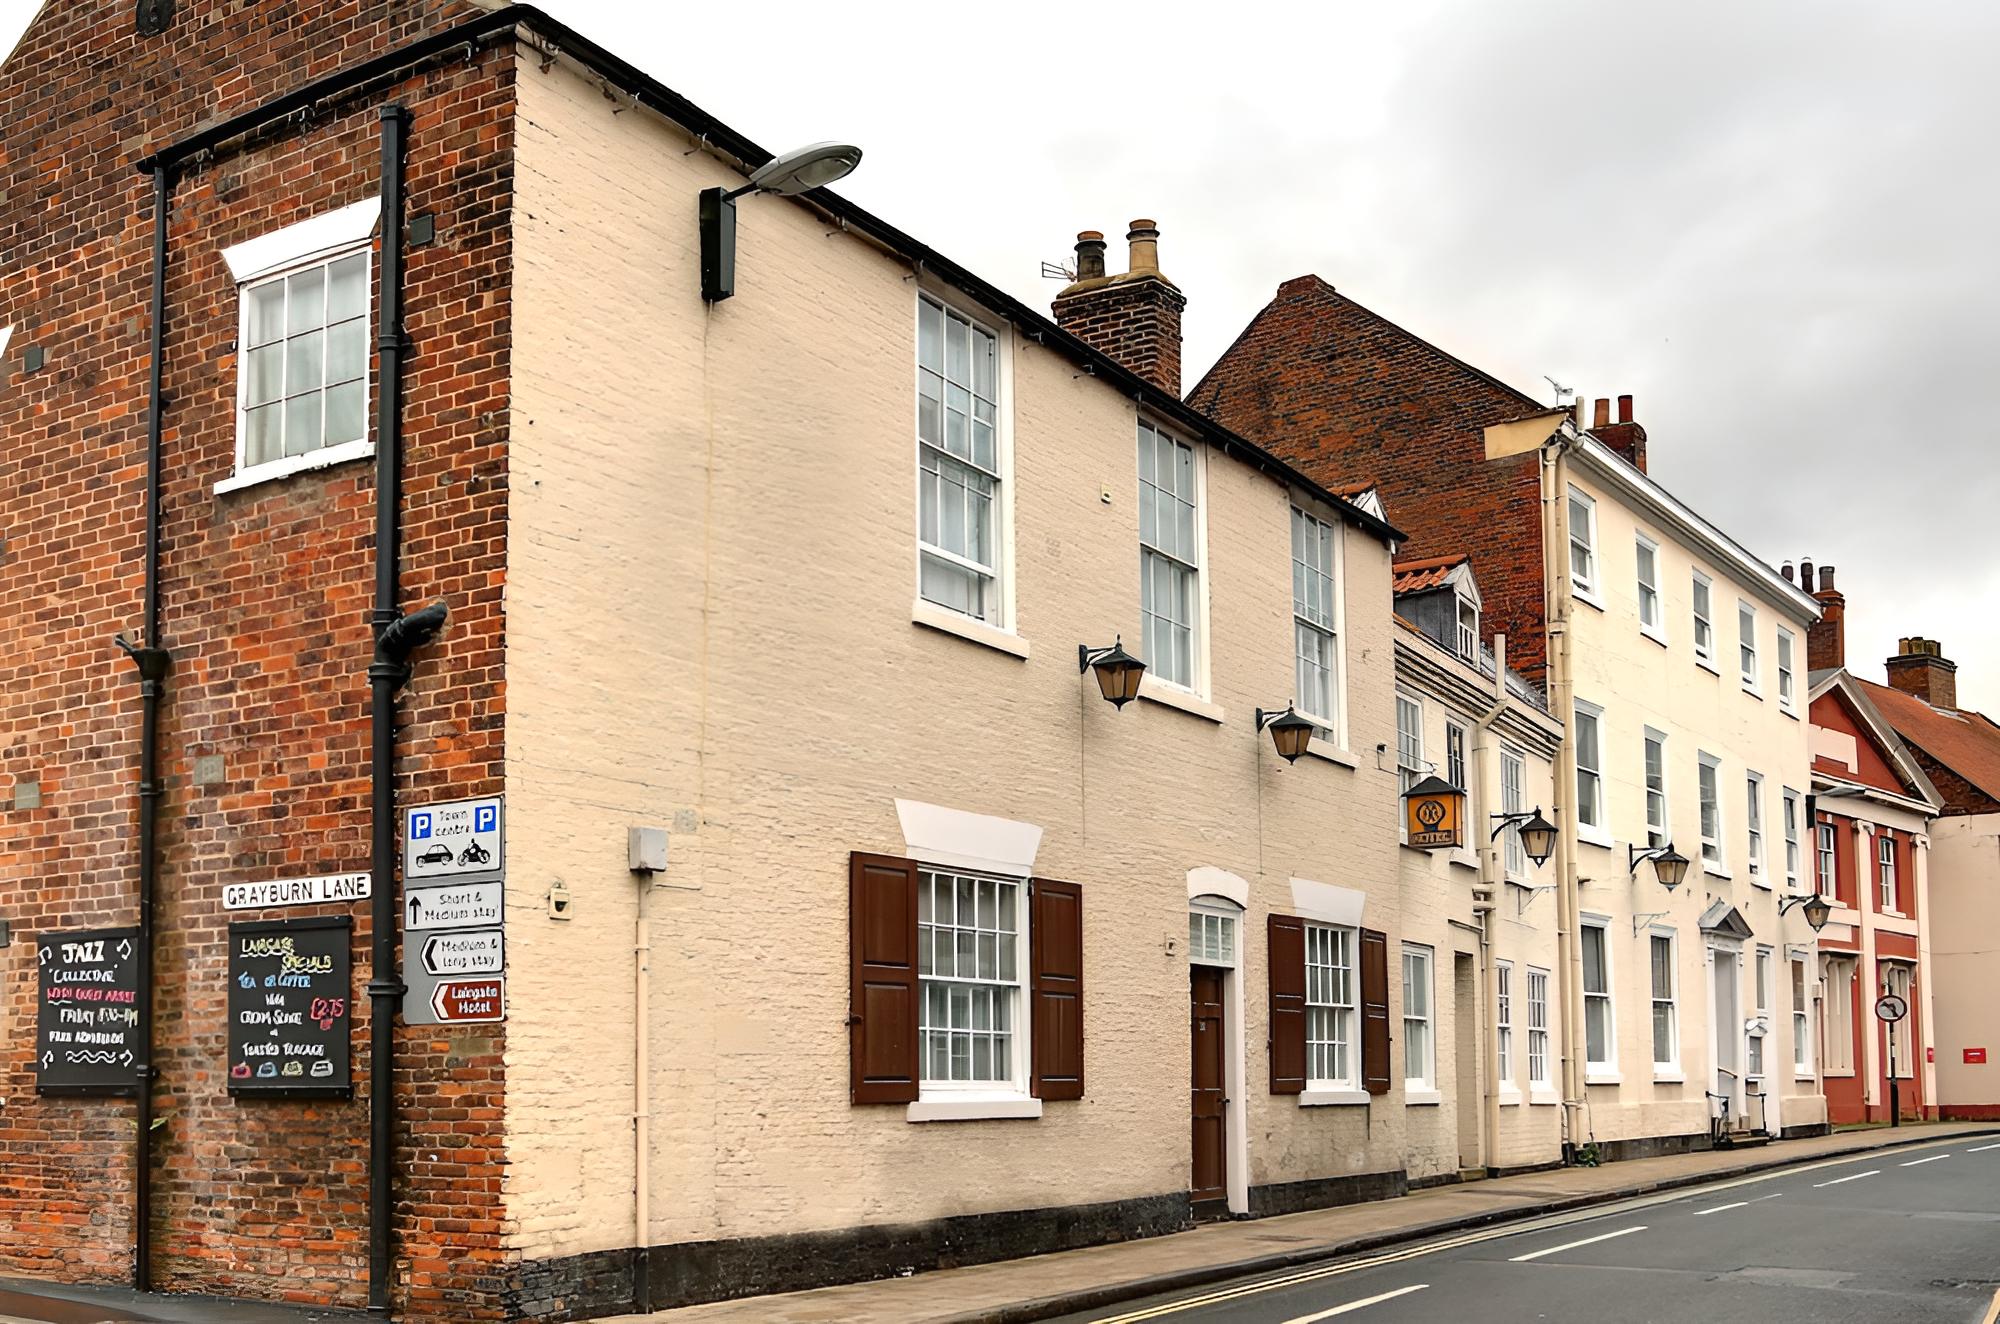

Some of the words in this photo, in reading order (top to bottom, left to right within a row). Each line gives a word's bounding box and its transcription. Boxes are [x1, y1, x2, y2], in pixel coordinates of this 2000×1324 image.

[416, 815, 429, 838] P
[440, 810, 468, 822] Town
[479, 808, 493, 831] P
[435, 824, 470, 836] centre
[227, 881, 313, 905] GRAYBURN
[323, 876, 367, 899] LANE
[440, 893, 470, 905] Short
[61, 940, 105, 964] JAZZ
